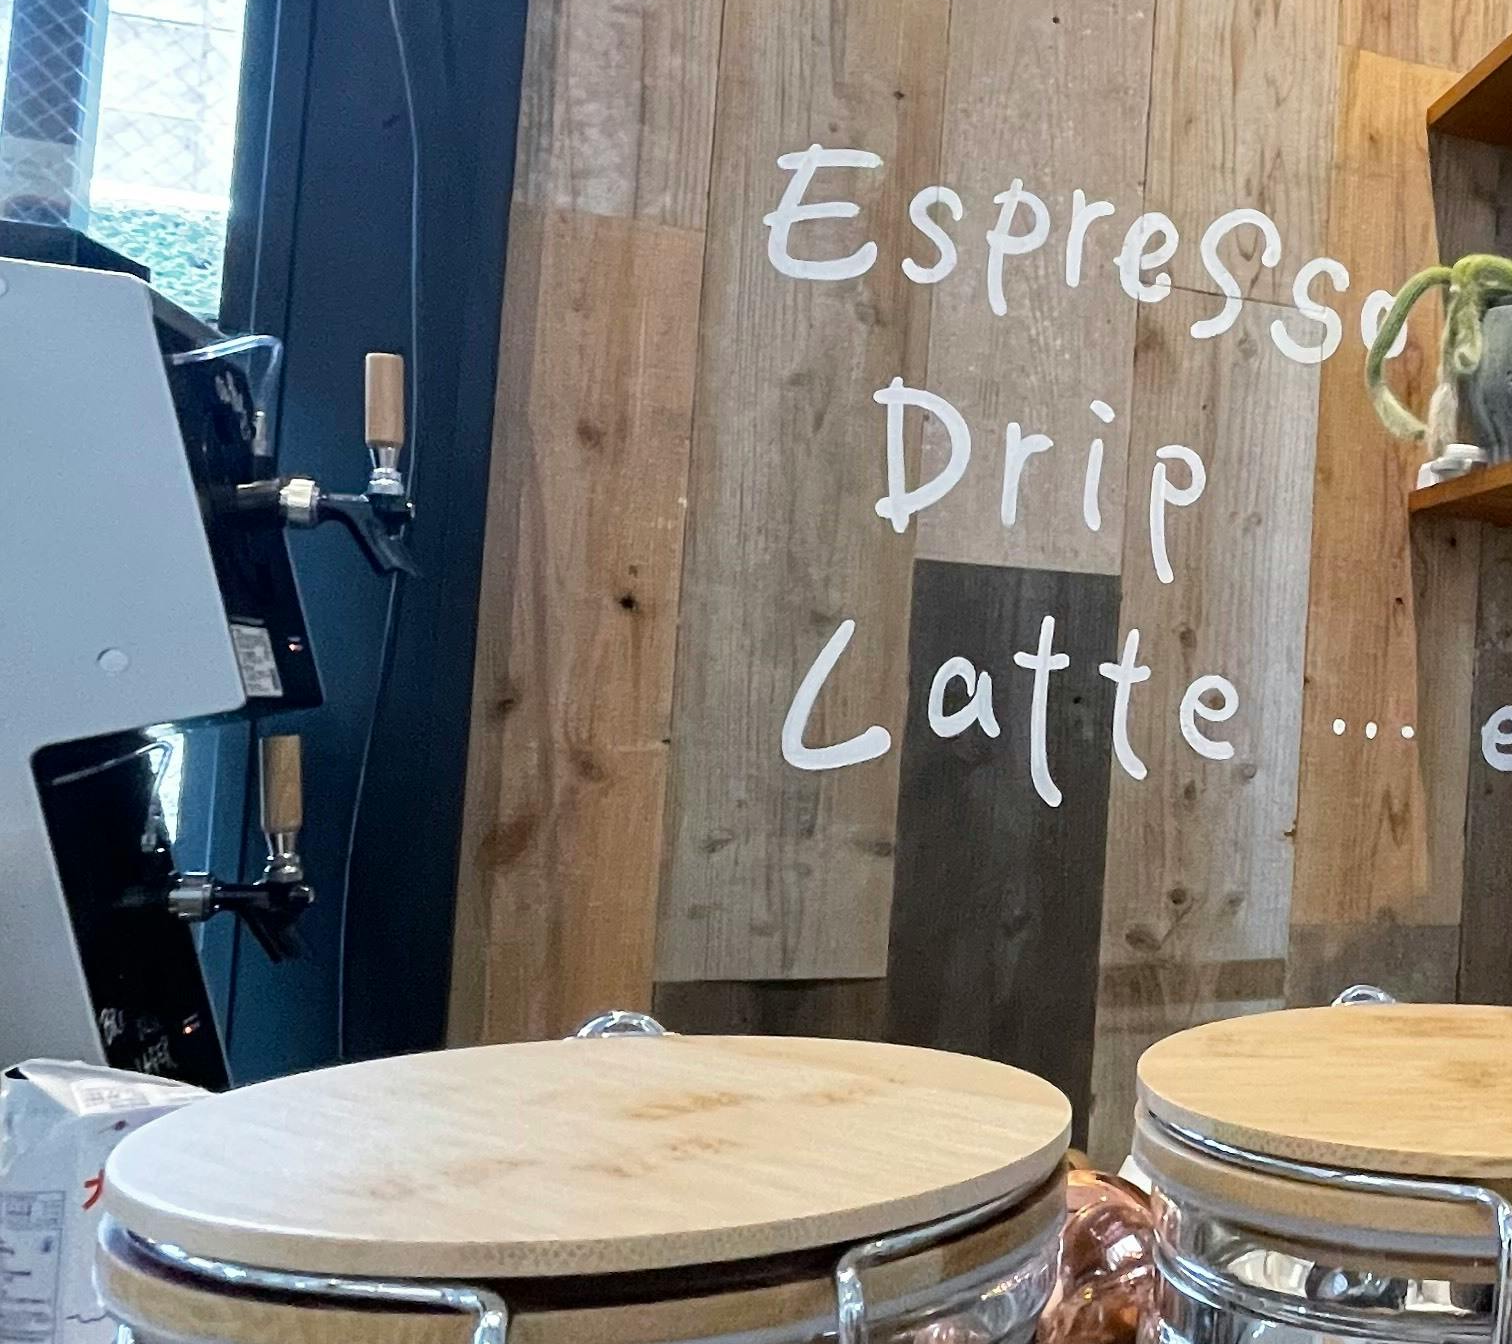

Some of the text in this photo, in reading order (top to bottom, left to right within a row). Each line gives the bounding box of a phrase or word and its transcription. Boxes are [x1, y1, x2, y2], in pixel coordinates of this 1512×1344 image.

[762, 143, 1408, 364] Espresso
[873, 376, 1207, 584] Drip
[782, 615, 1240, 809] Latte
